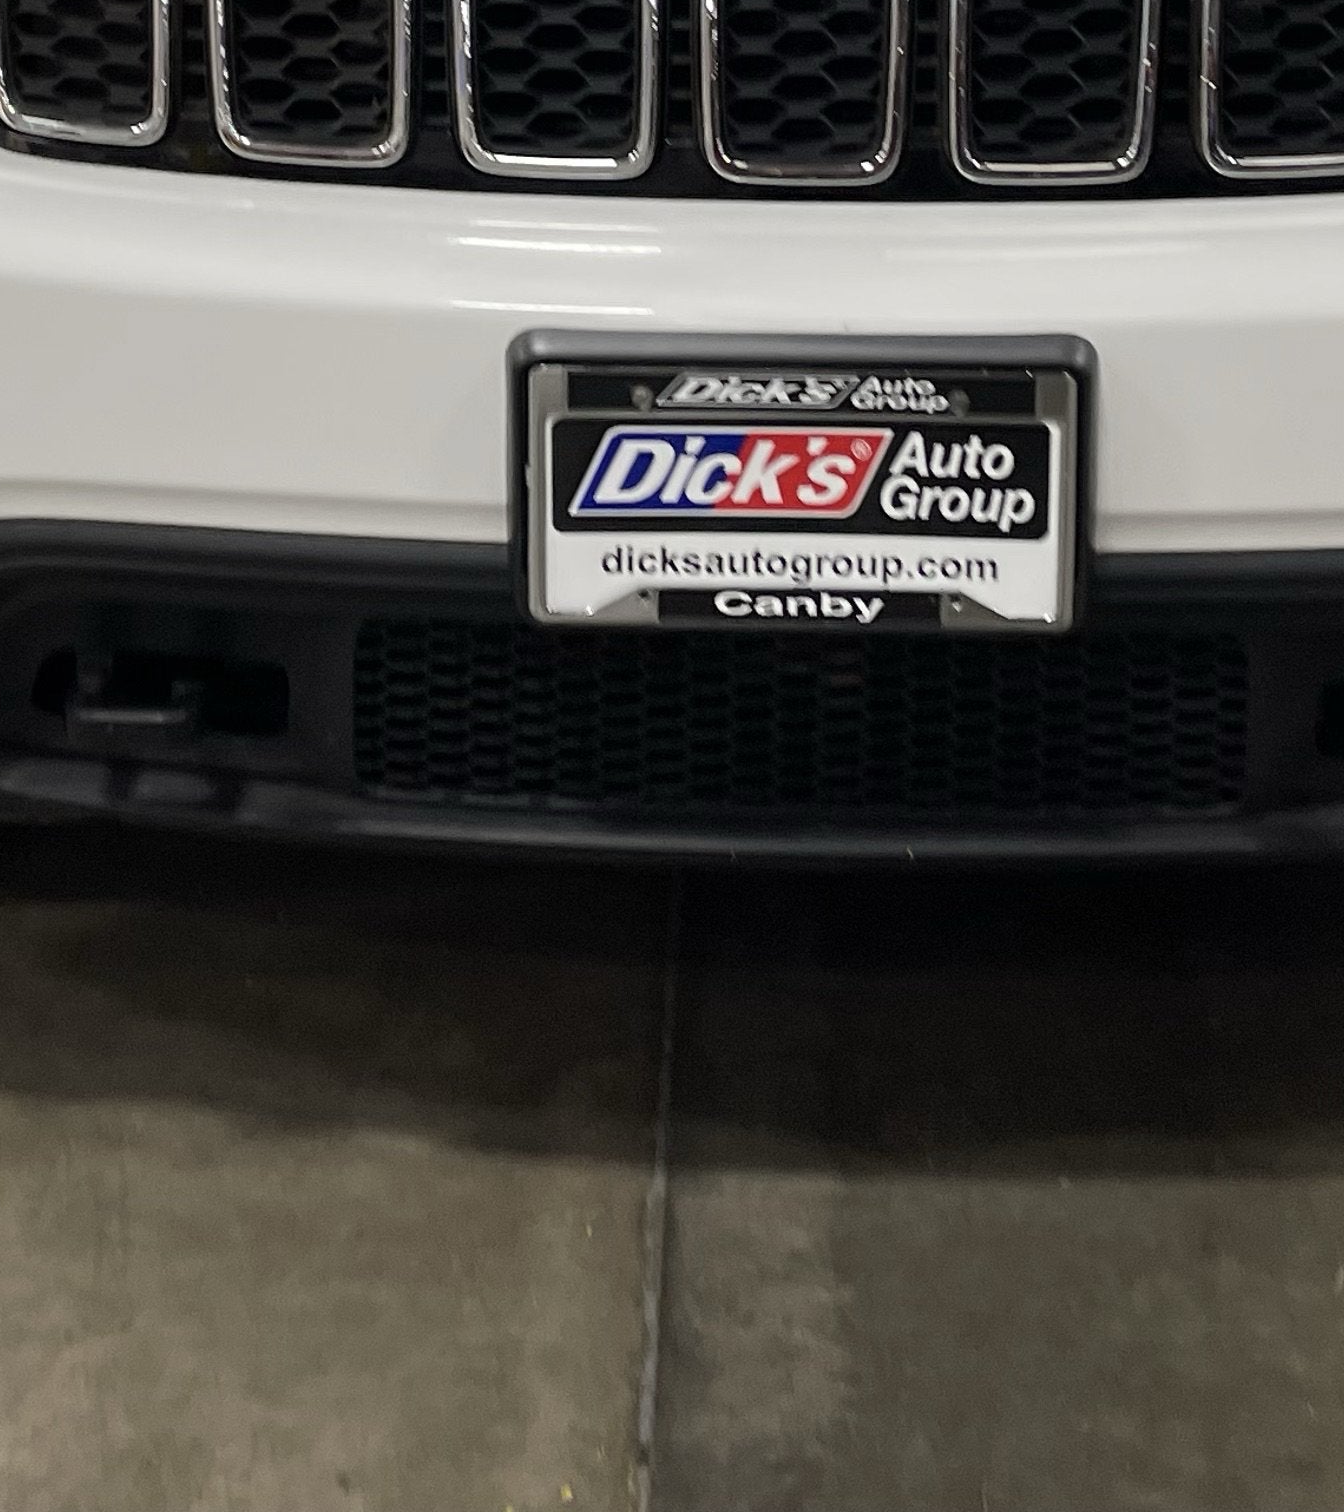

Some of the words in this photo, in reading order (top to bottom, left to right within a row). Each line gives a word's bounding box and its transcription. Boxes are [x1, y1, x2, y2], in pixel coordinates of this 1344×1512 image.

[849, 391, 950, 414] Group
[859, 375, 936, 395] Auto
[593, 435, 856, 507] Dick's
[889, 430, 1016, 481] Auto
[879, 473, 1037, 532] Group
[600, 544, 1000, 585] dicksautogroup.com
[713, 590, 886, 625] Canby
